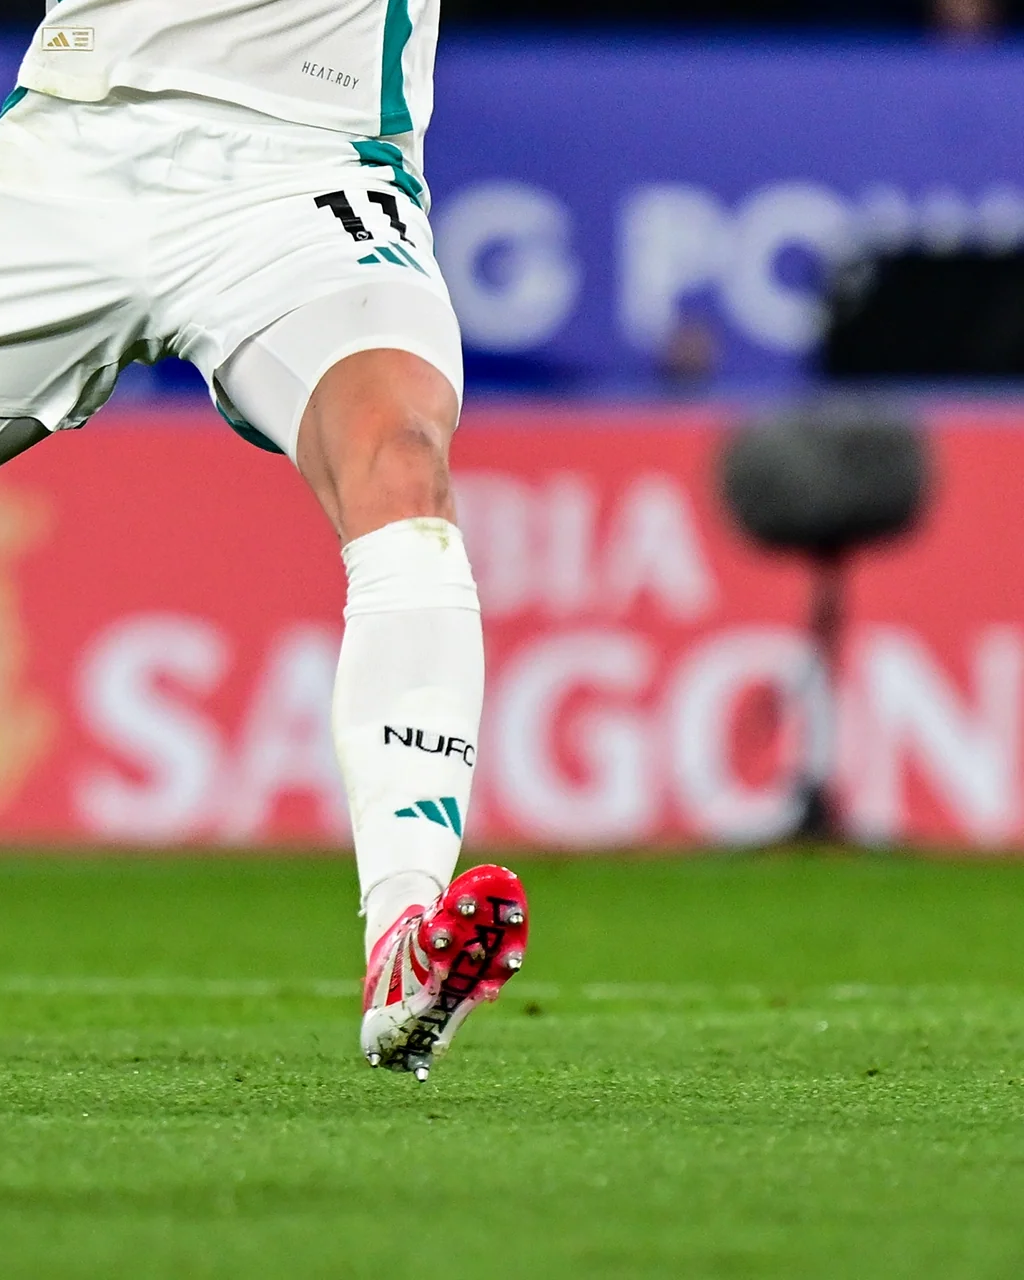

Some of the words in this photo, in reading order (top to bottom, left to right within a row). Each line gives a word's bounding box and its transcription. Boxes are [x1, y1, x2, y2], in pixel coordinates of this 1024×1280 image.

[313, 190, 416, 249] 11
[72, 612, 1024, 846] SAGON
[384, 725, 475, 767] NUFC
